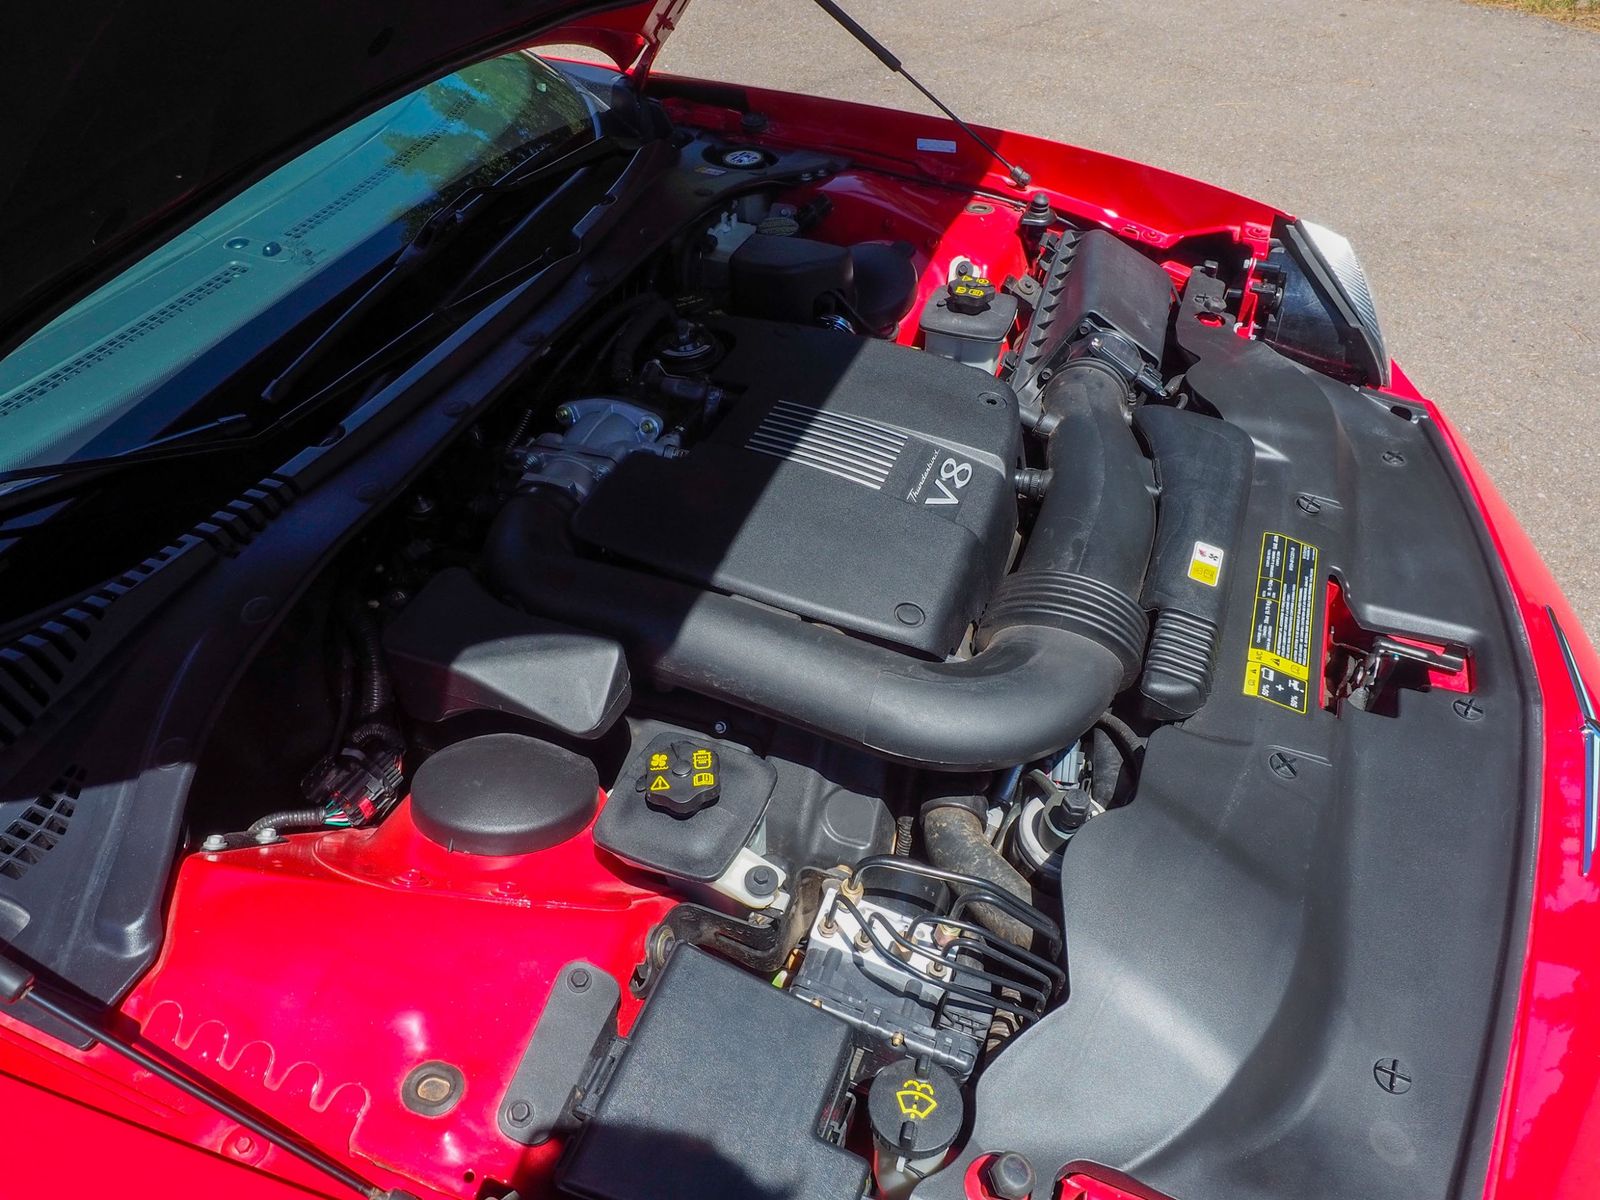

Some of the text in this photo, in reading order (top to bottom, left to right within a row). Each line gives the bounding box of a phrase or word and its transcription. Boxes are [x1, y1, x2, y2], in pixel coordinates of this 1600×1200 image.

[906, 448, 940, 503] Thunderbird
[924, 457, 973, 505] V8
[1255, 651, 1263, 661] A/C
[1261, 684, 1270, 697] 50%
[1290, 695, 1299, 708] 50%
